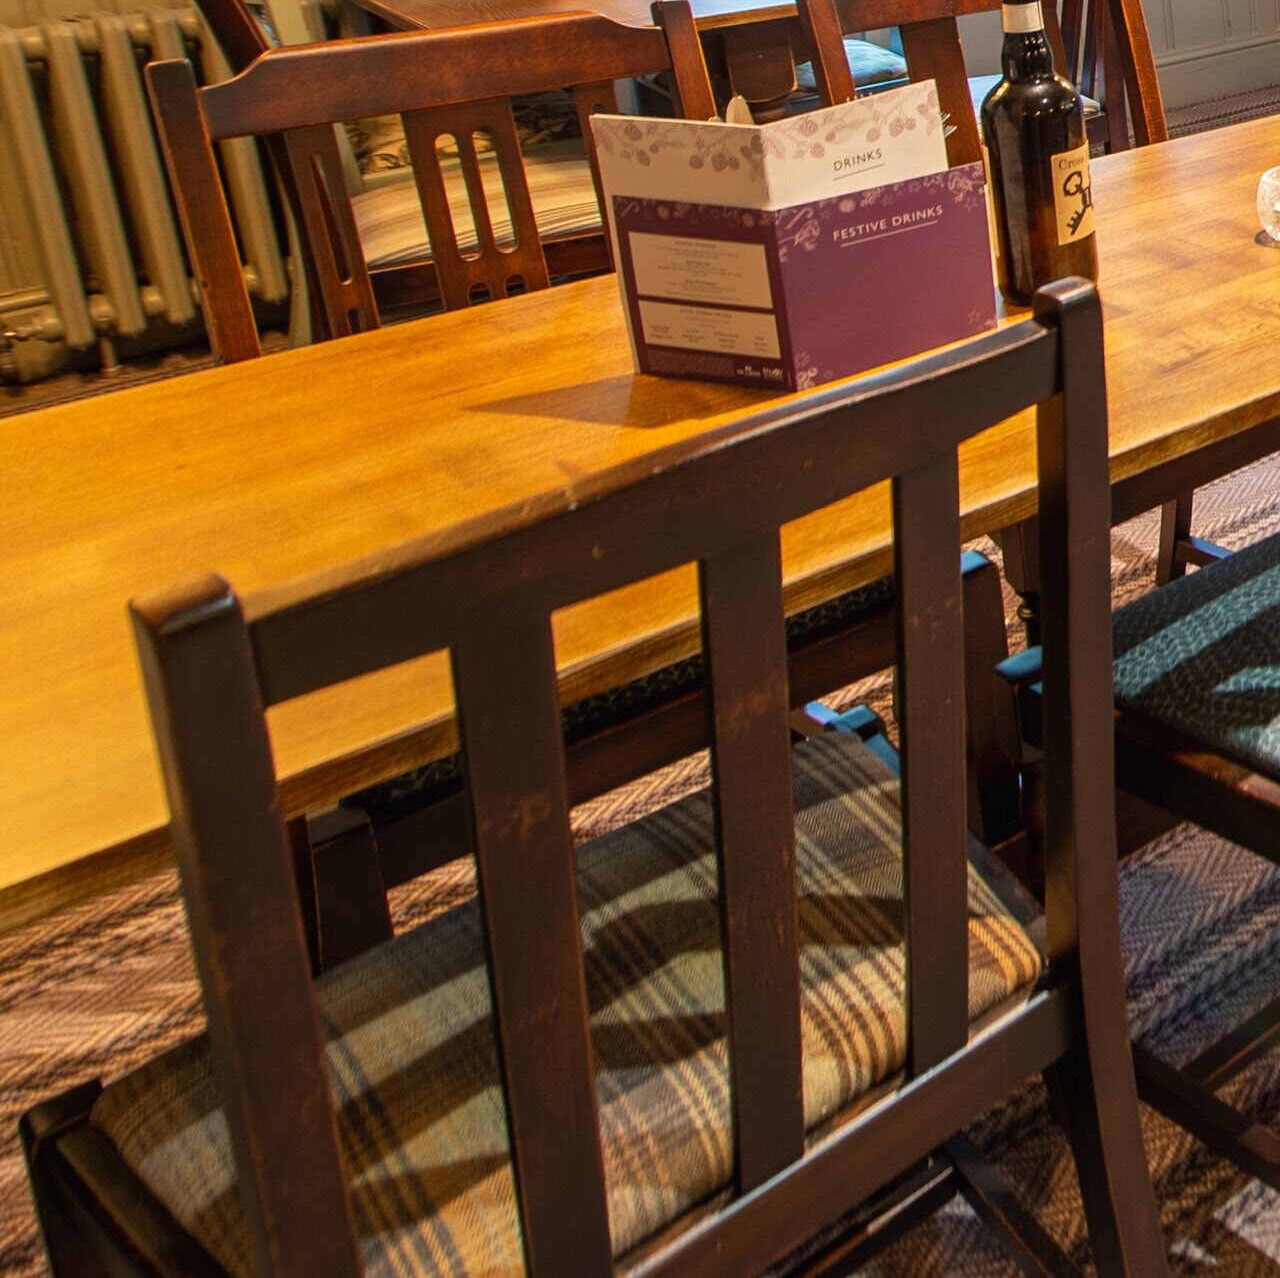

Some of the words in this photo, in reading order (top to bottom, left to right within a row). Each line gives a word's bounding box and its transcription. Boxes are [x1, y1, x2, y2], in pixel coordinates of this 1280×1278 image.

[833, 148, 882, 172] DRINKS
[833, 219, 887, 242] FESTIVE
[892, 205, 944, 227] DRINKS
